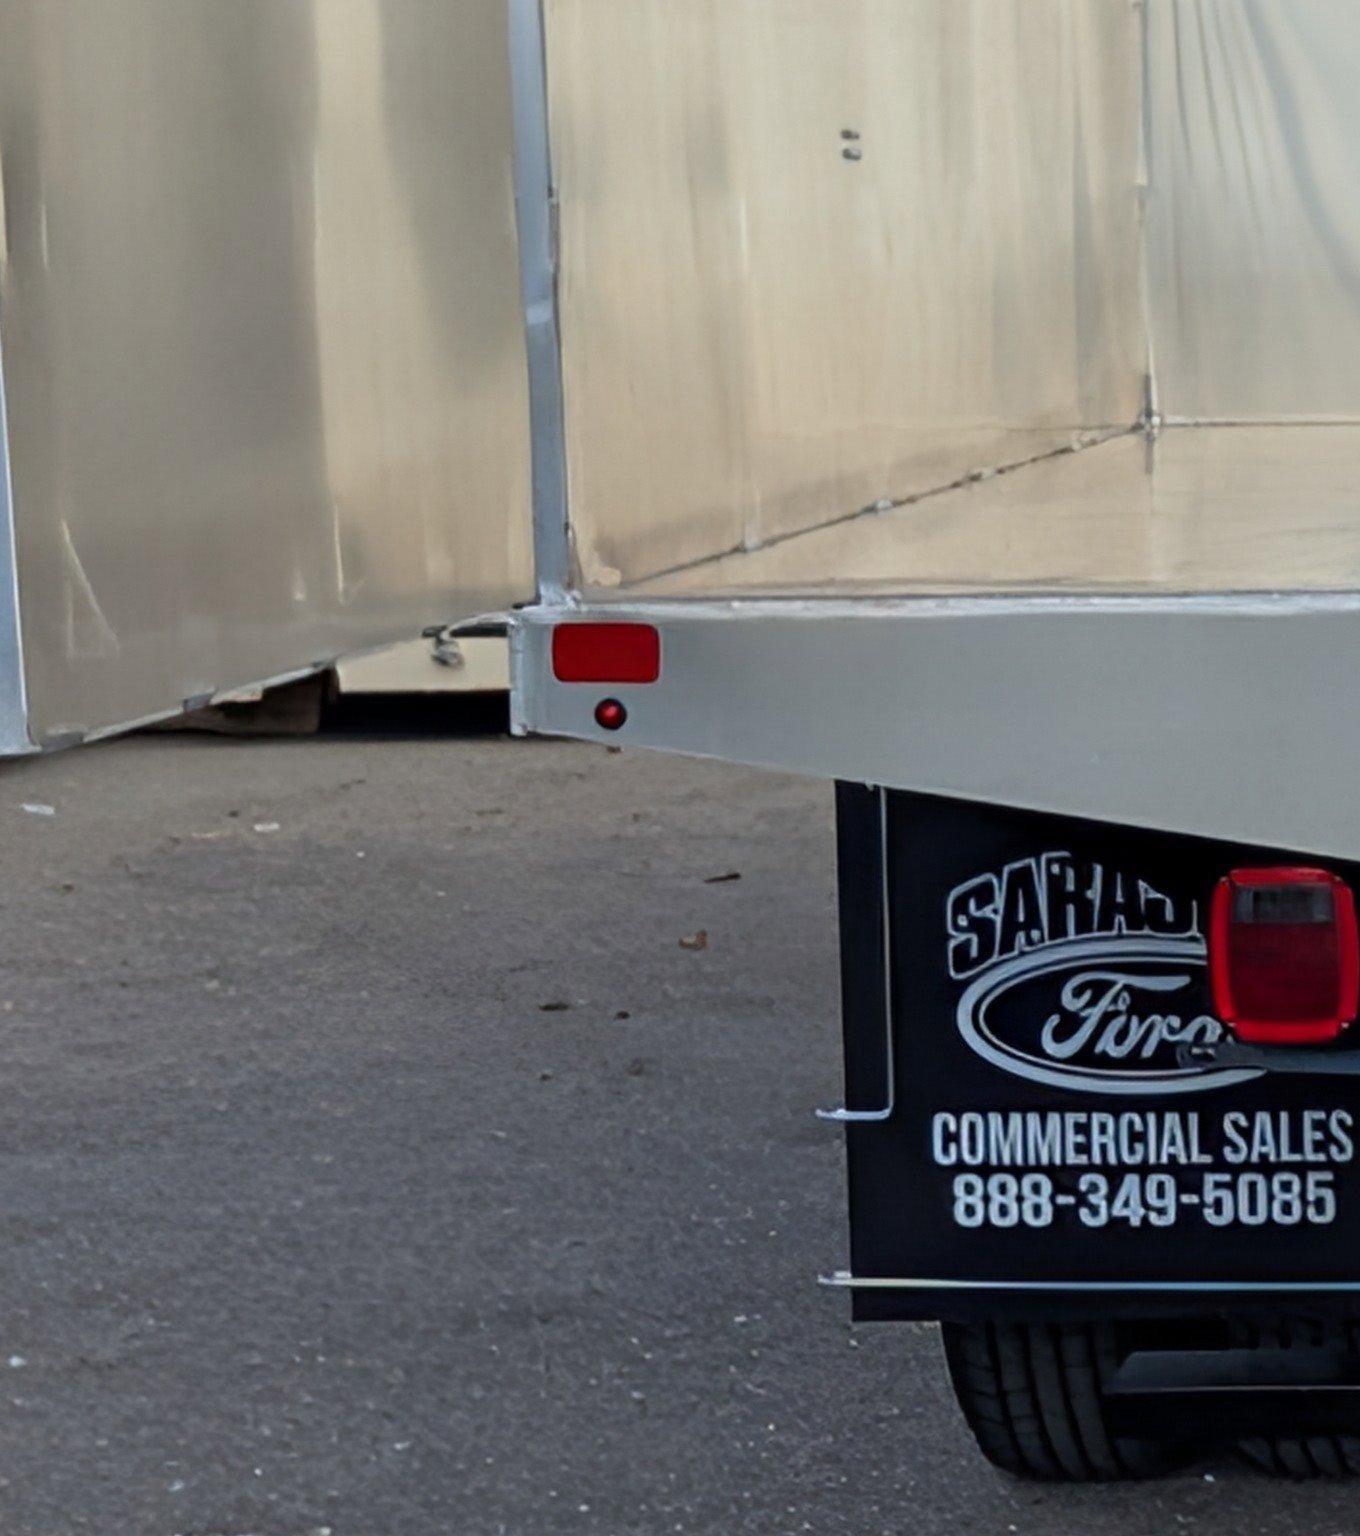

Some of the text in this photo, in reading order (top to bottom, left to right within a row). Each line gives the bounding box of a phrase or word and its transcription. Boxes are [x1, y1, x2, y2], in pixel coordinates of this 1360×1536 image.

[947, 851, 1206, 980] SARAS
[931, 1110, 1355, 1167] COMMERCIAL SALES
[951, 1171, 1338, 1228] 888-349-5085
